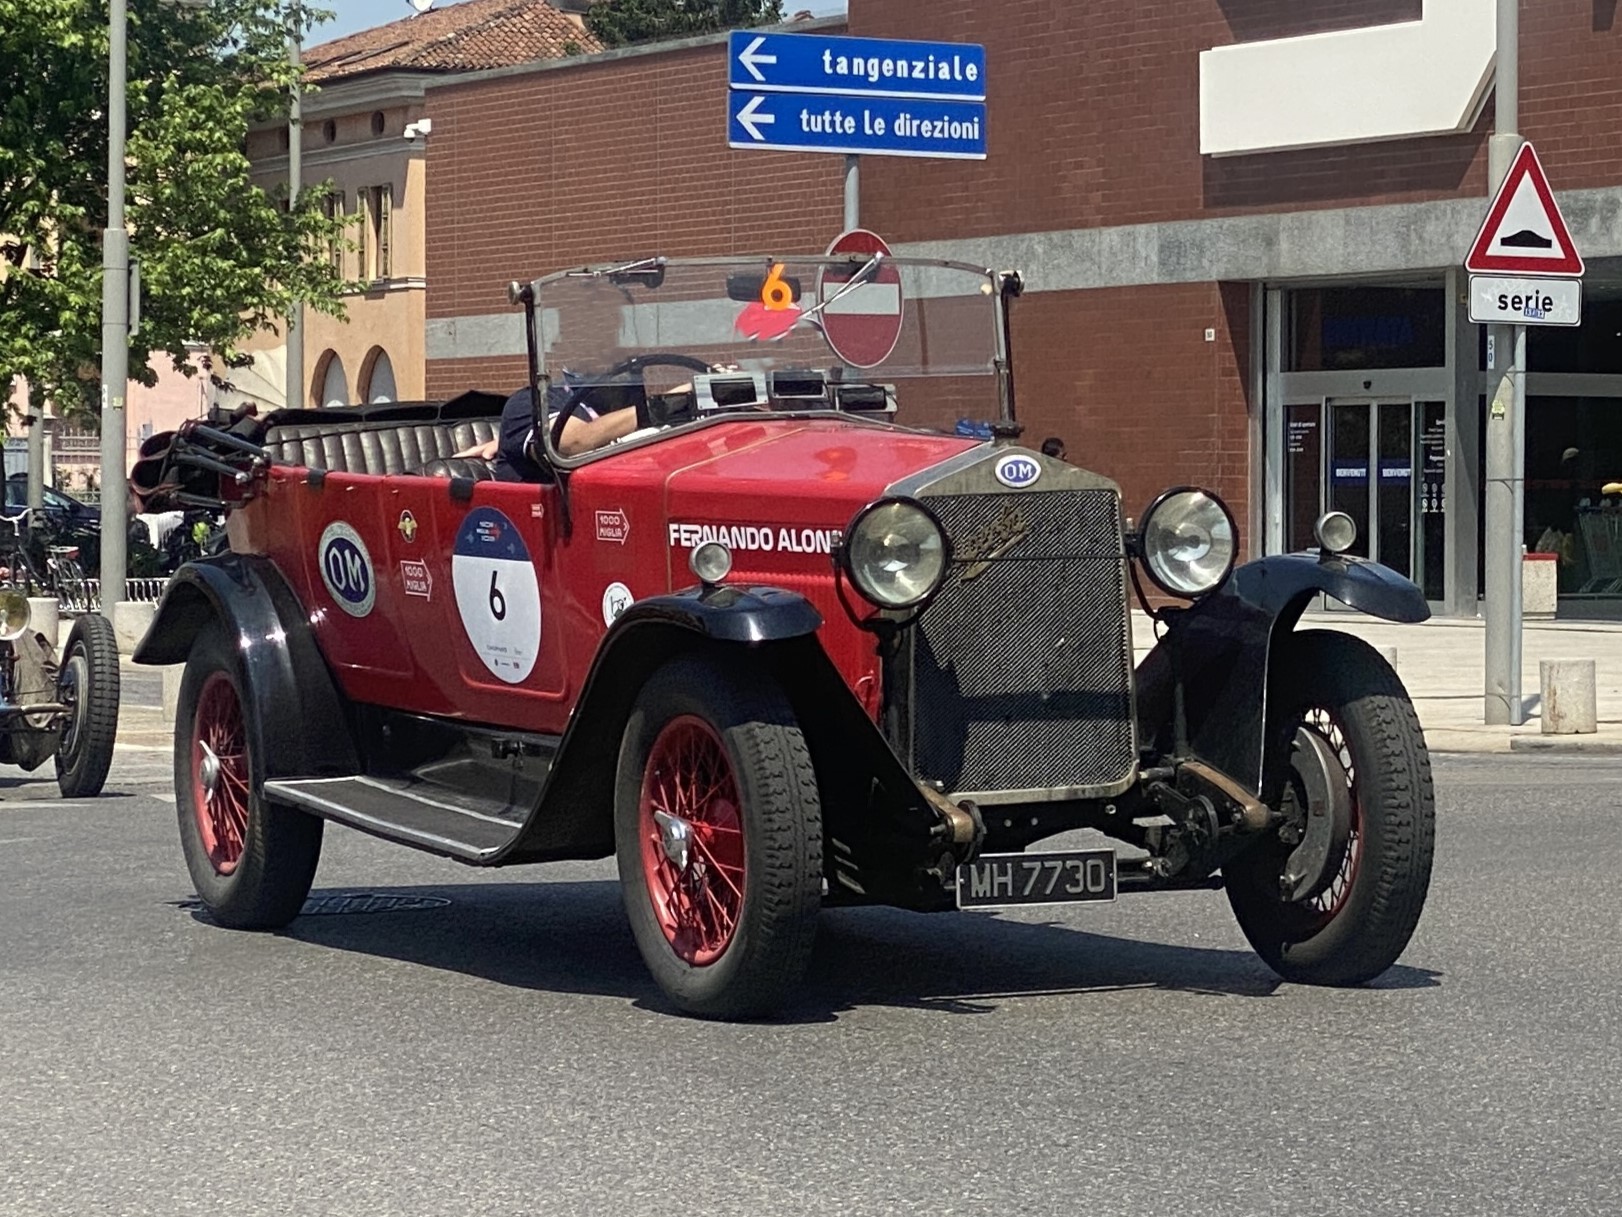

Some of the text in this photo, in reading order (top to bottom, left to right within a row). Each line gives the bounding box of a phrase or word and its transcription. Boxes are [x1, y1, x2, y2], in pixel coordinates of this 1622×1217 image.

[822, 49, 978, 82] tangenziale
[800, 108, 980, 140] tutte le direzioni
[761, 263, 793, 312] 6
[1498, 289, 1554, 312] serie
[1004, 463, 1033, 479] OM
[599, 515, 620, 525] 1000
[599, 527, 622, 538] MIGLIA
[668, 523, 774, 551] FERNANDO
[328, 546, 365, 592] OM
[404, 565, 423, 577] 1000
[489, 570, 506, 621] 6
[970, 859, 1106, 898] MH 7730
